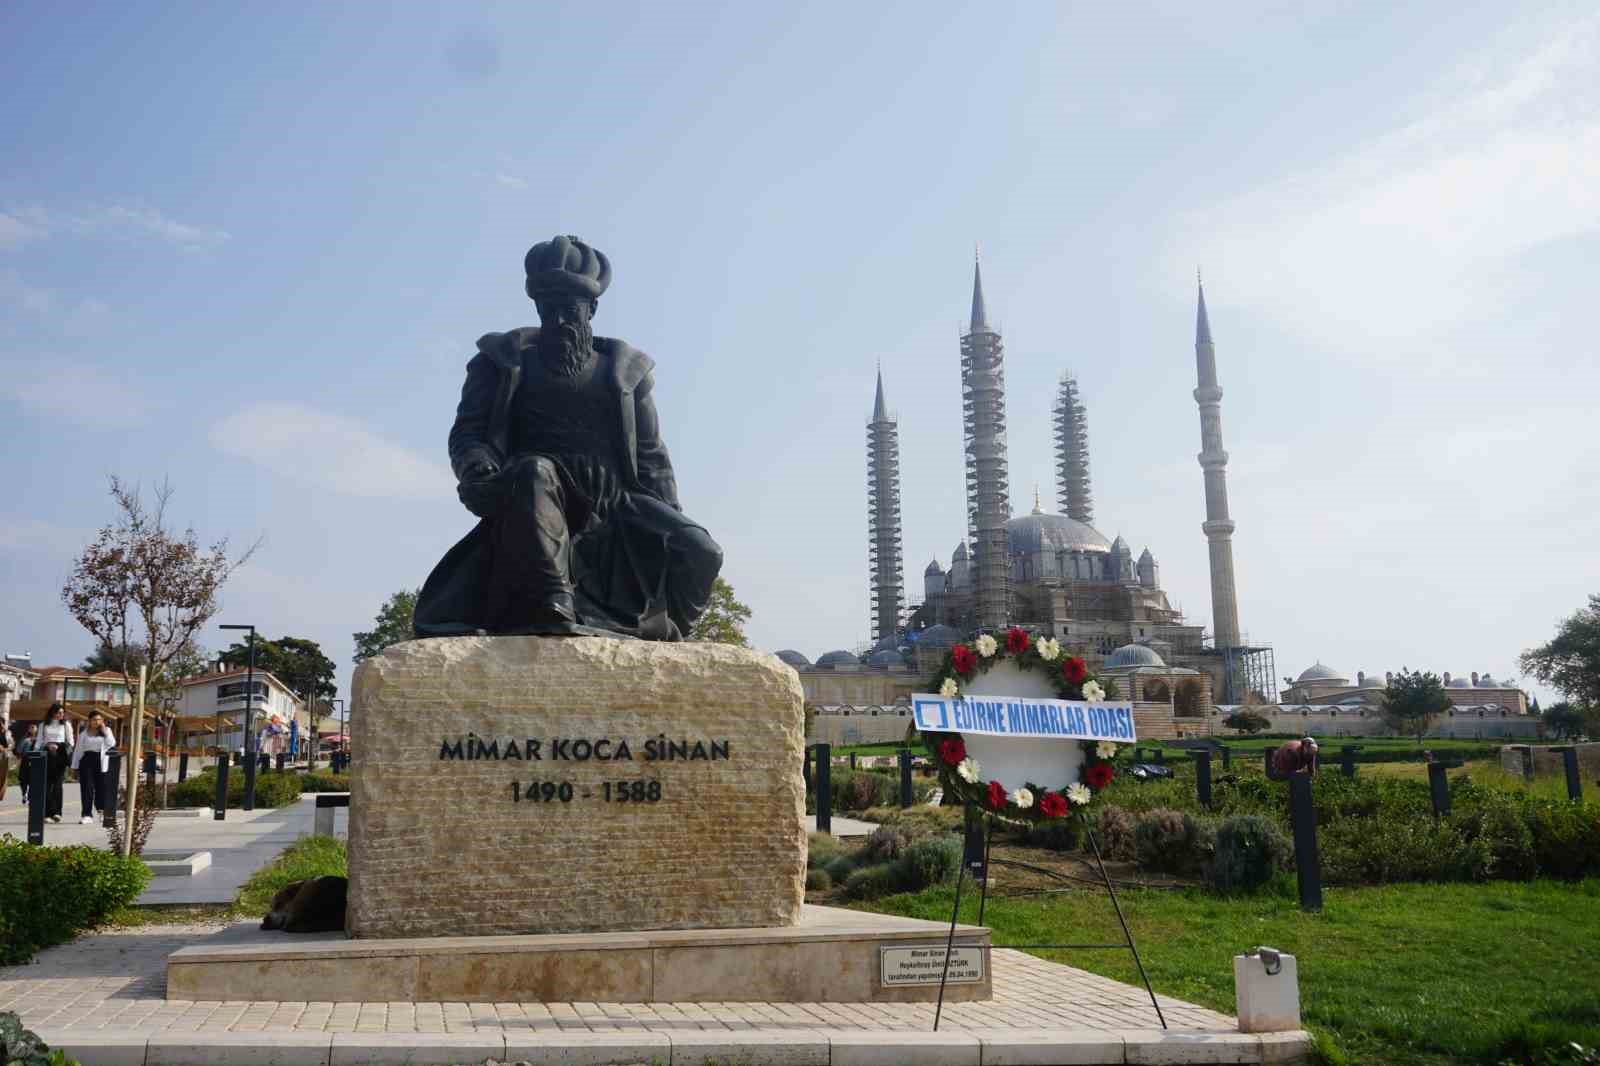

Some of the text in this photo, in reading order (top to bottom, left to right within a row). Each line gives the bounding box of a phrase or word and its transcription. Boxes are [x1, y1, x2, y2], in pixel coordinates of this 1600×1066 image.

[952, 697, 1134, 739] EDİRNE MİMARLAR ODASI
[439, 732, 730, 761] MİMAR KOCA SİNAN
[511, 781, 574, 803] 1490
[601, 781, 662, 803] 1588
